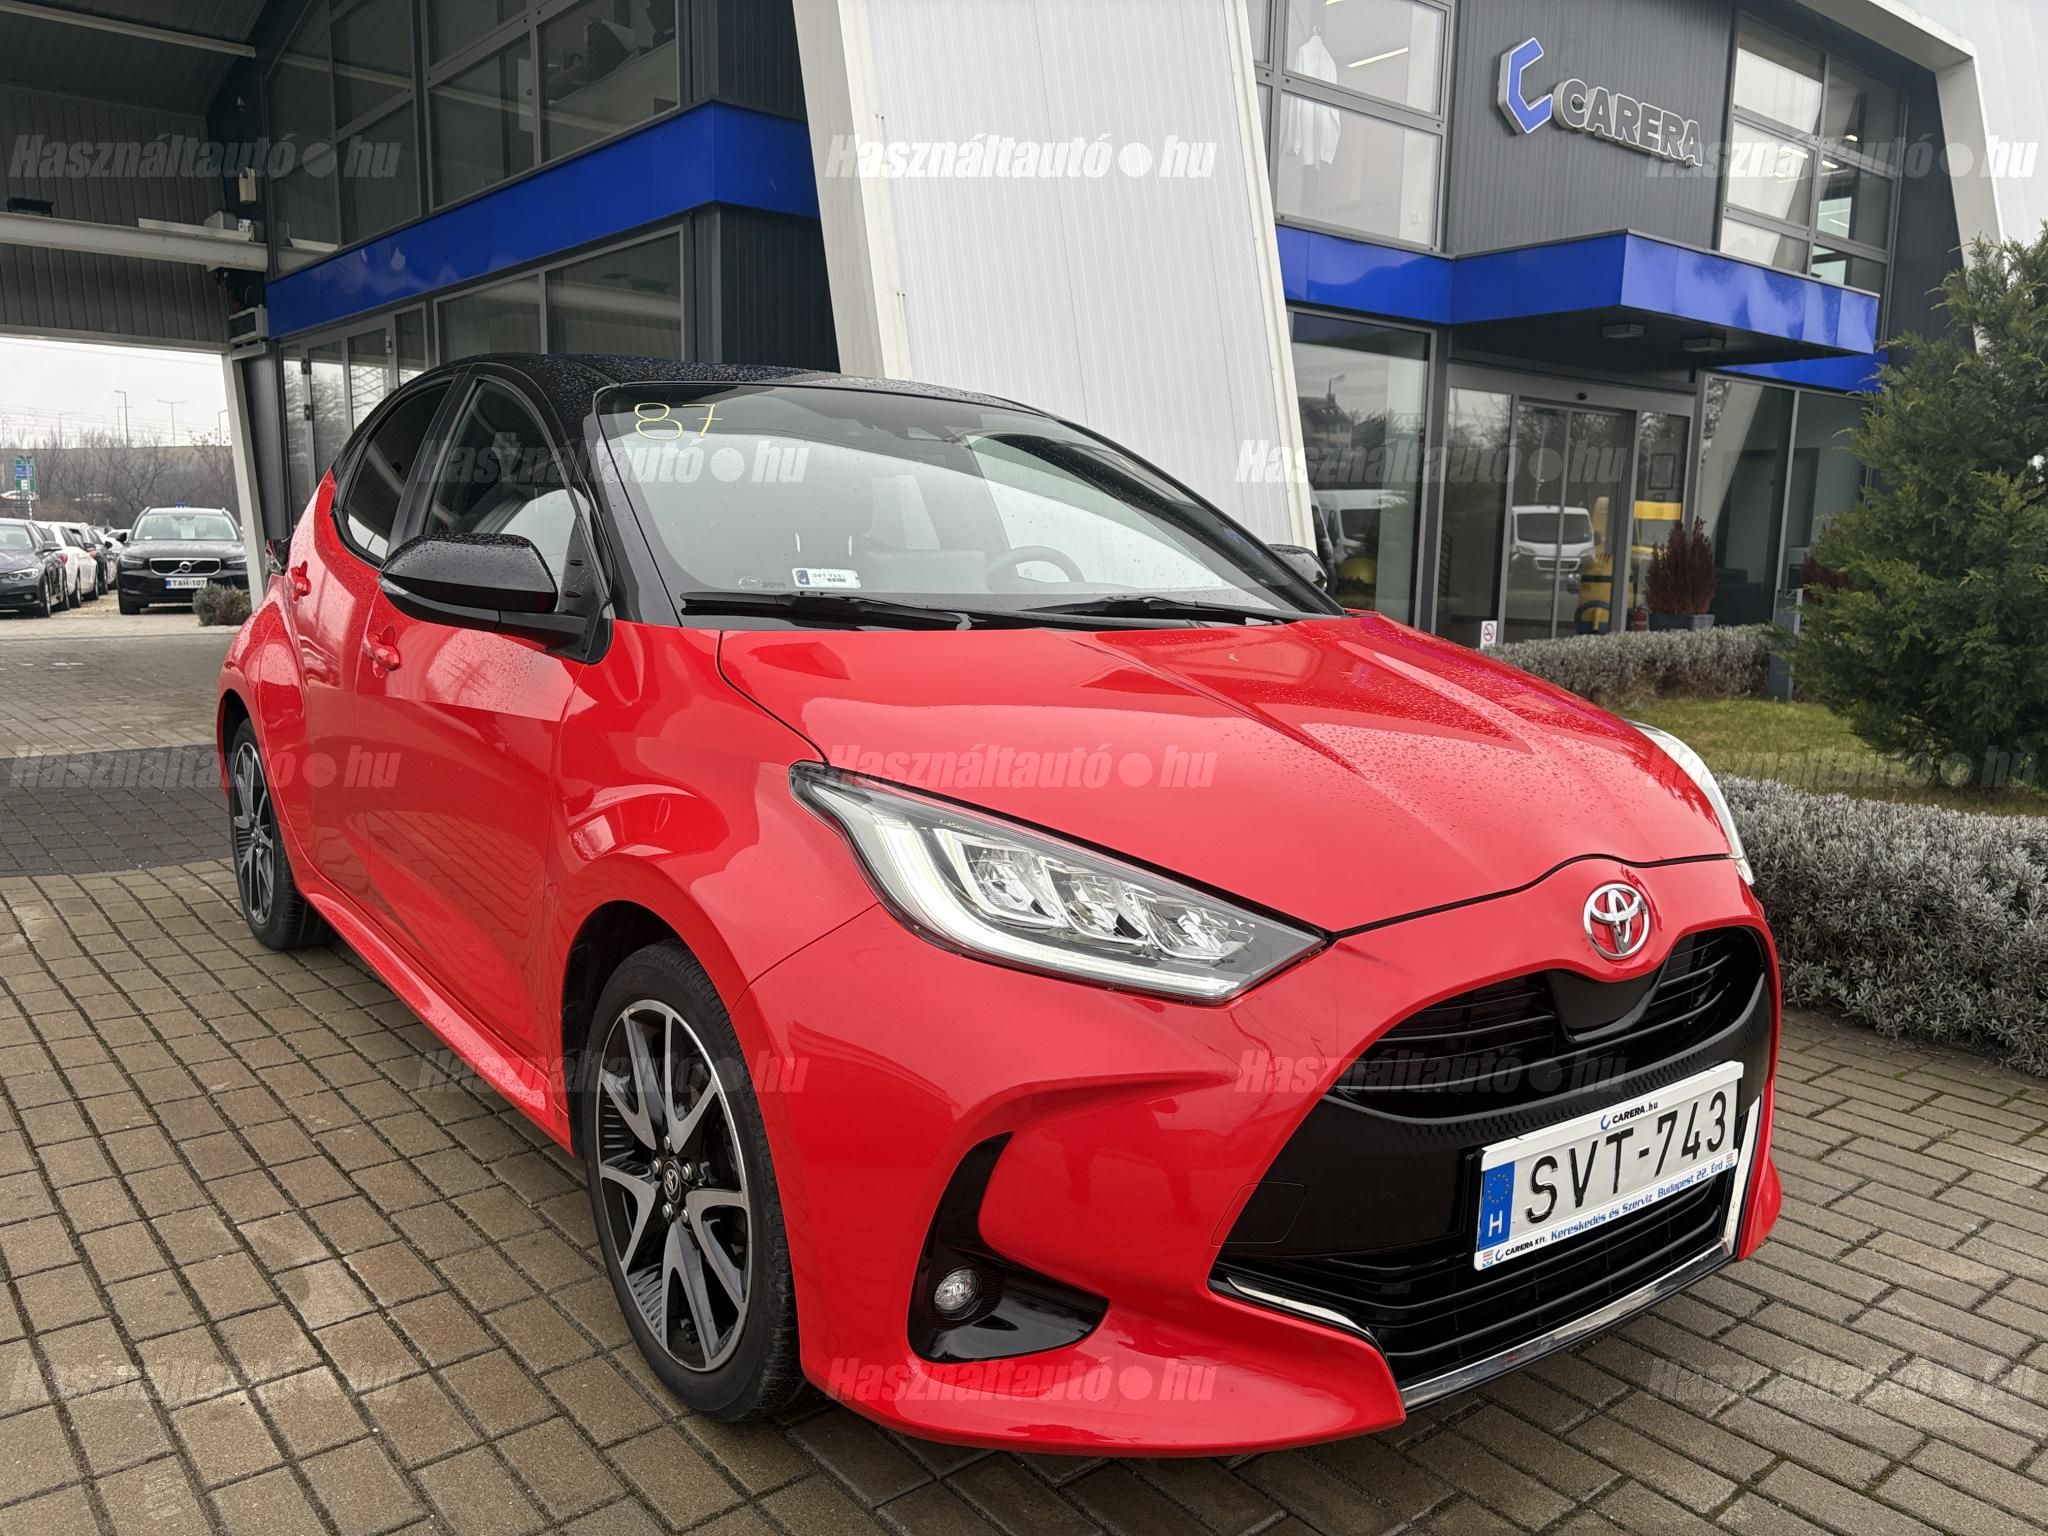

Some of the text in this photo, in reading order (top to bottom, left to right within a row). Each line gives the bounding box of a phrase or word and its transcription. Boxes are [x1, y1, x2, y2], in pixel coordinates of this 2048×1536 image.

[1553, 78, 1703, 168] CARERA
[634, 402, 723, 440] 87
[1612, 1100, 1659, 1125] CARERA.hu
[1524, 1090, 1728, 1224] SVT-743
[1487, 1210, 1503, 1237] H
[1505, 1240, 1534, 1257] CARERA
[1534, 1235, 1548, 1247] Kft.
[1550, 1212, 1607, 1241] Kereskedés
[1608, 1206, 1620, 1219] és
[1621, 1192, 1654, 1214] Szerviz
[1657, 1174, 1695, 1198] Budapest
[1710, 1159, 1723, 1174] Érd
